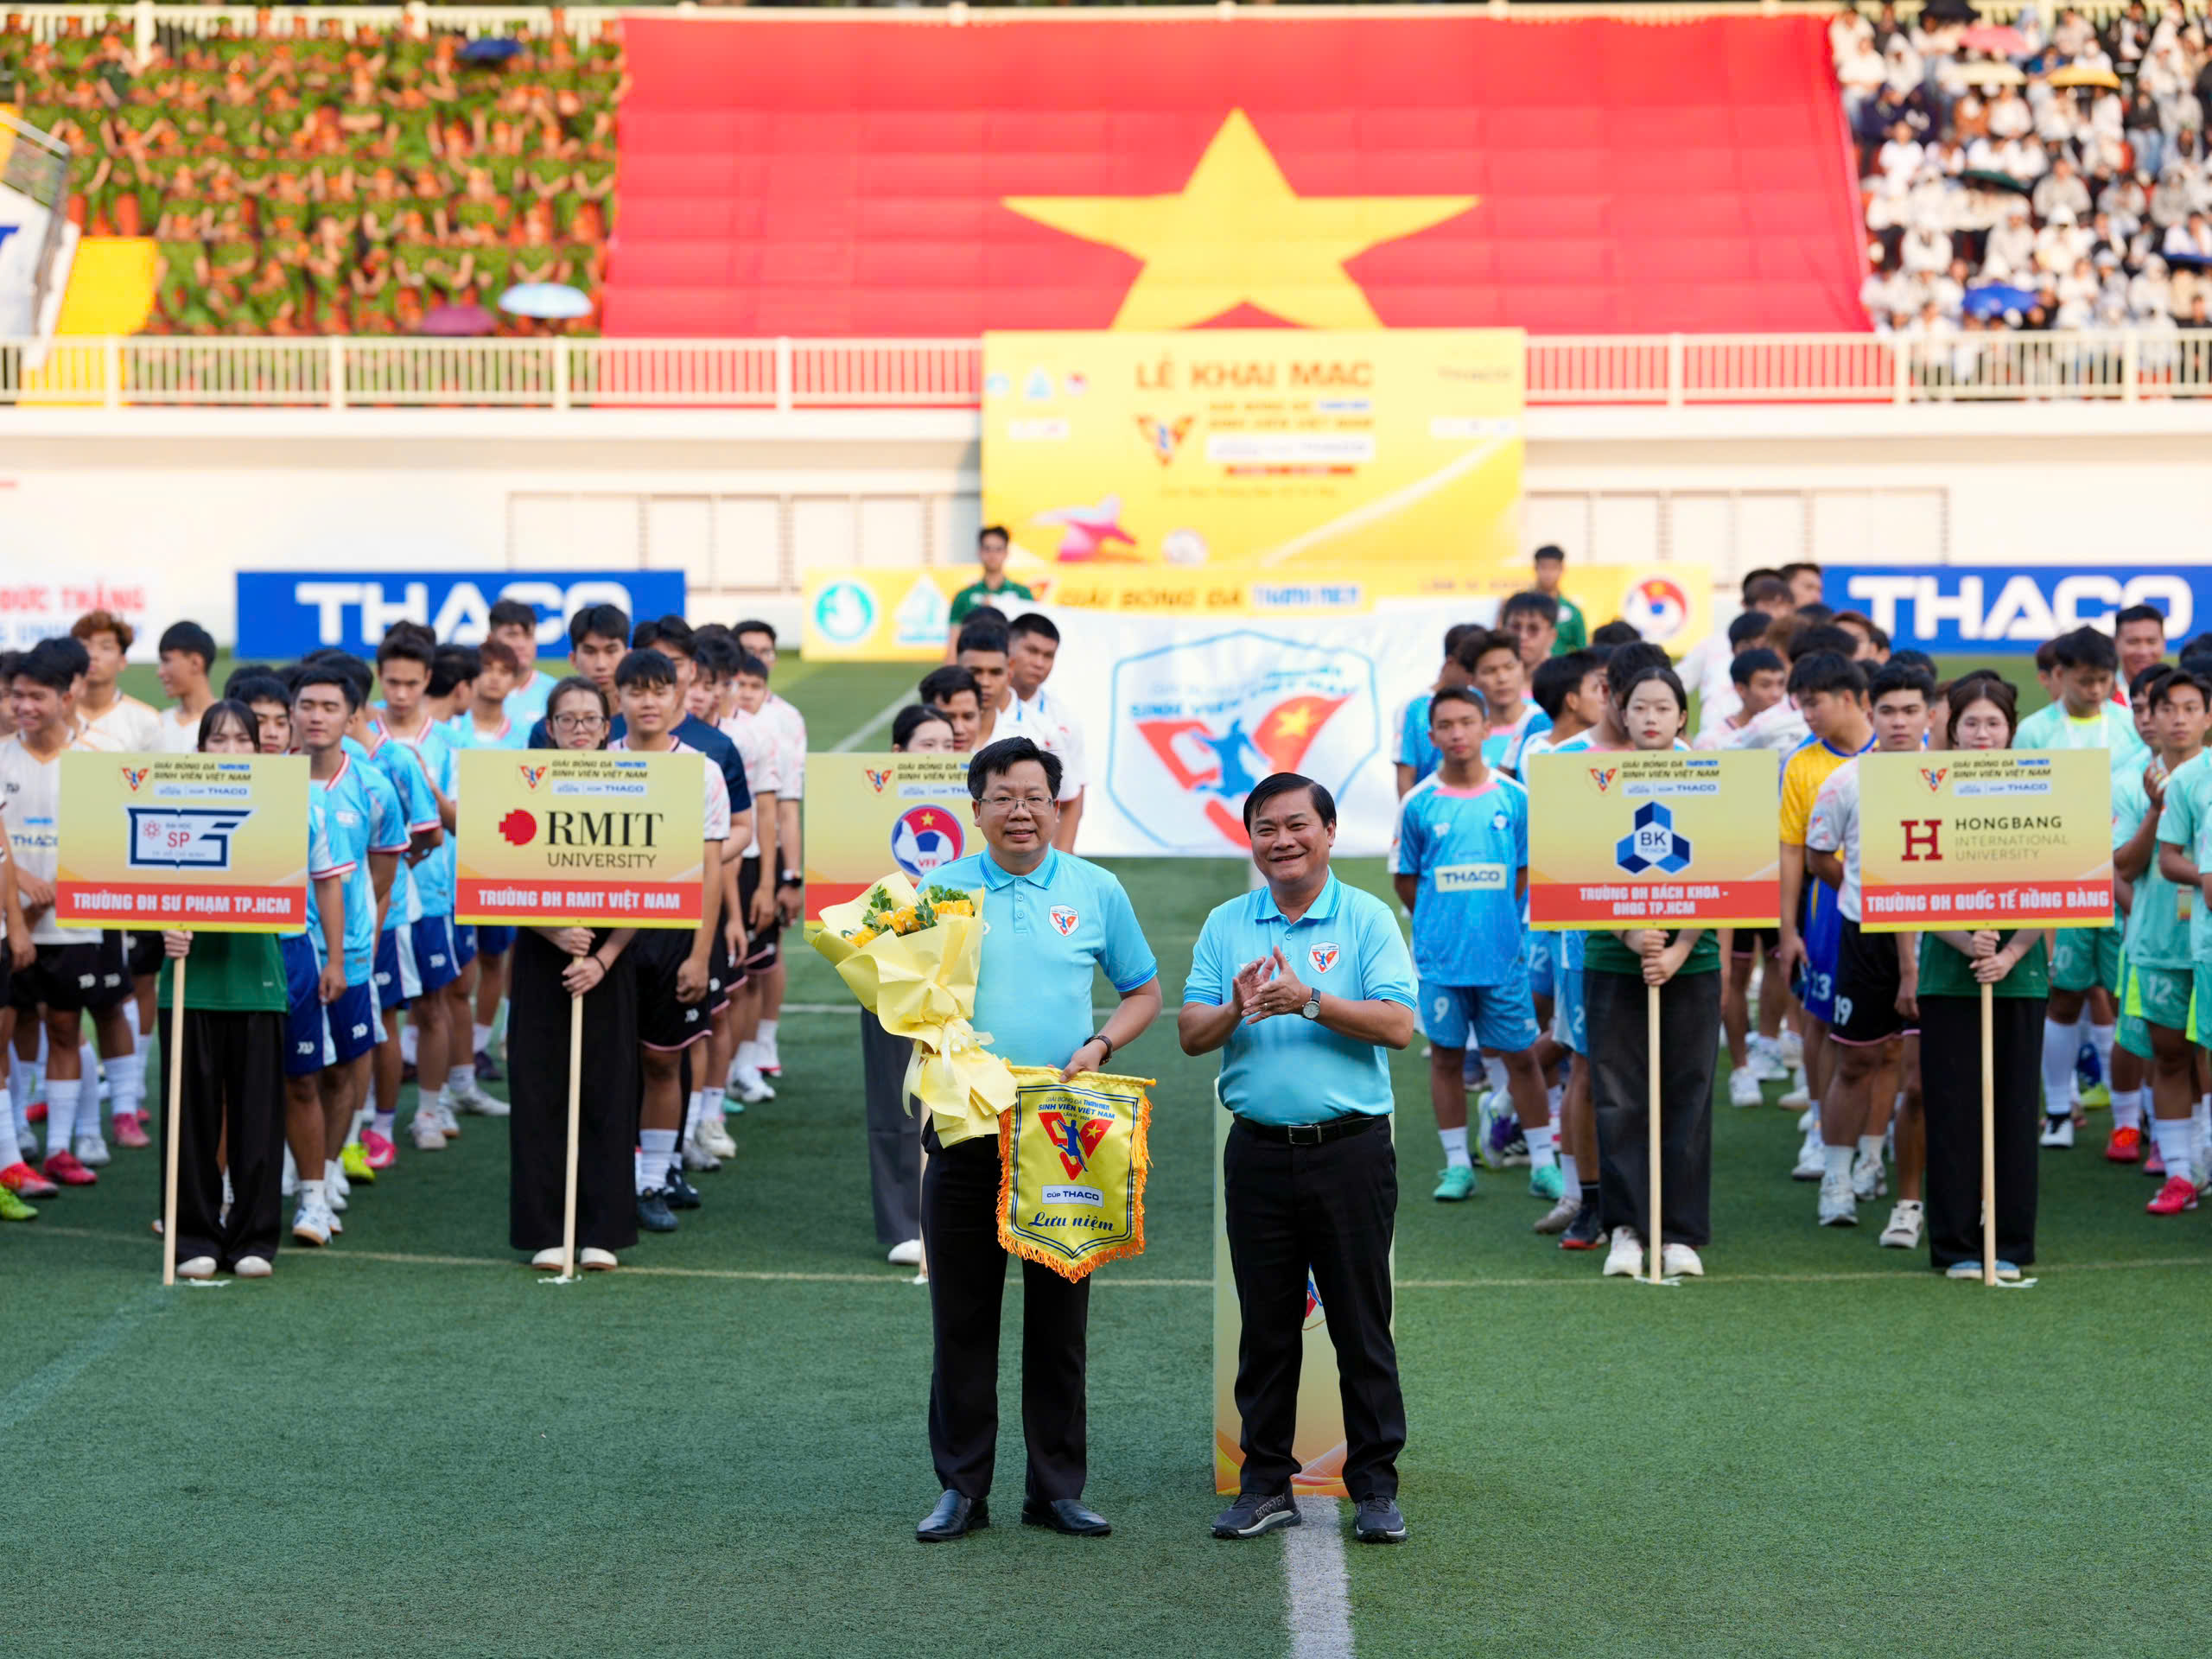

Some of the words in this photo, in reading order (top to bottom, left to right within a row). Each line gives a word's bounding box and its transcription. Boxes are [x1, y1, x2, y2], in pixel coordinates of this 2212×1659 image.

[1848, 575, 2193, 639] THACO
[1676, 784, 1716, 792] THACO
[544, 810, 664, 848] RMIT
[1955, 816, 2063, 830] HONGBANG
[167, 831, 190, 848] SP
[1641, 832, 1666, 846] BK
[1900, 819, 1943, 861] H
[1955, 834, 2068, 848] INTERNATIONAL
[547, 852, 657, 868] UNIVERSITY
[1955, 849, 2040, 861] UNIVERSITY
[1441, 870, 1500, 884] THACO
[479, 887, 537, 906] TRƯỜNG
[566, 892, 605, 908] RMIT
[608, 889, 640, 912] VIỆT
[644, 893, 680, 910] NAM
[1687, 886, 1719, 899] KHOA
[1866, 891, 1926, 912] TRƯỜNG
[2067, 887, 2109, 907] BÀNG
[73, 889, 133, 909] TRƯỜNG
[186, 895, 230, 914] PHẠM
[234, 896, 291, 913] TP.HCM
[1649, 901, 1695, 915] TP.HCM
[2149, 974, 2172, 1004] 12
[1433, 996, 1449, 1022] 9
[1834, 995, 1853, 1026] 19
[1058, 1103, 1077, 1111] VIÊN
[1077, 1106, 1096, 1116] VIỆT
[1097, 1110, 1116, 1119] NAM
[1063, 1191, 1099, 1201] THACO
[1028, 1211, 1067, 1227] Lưu
[1072, 1214, 1114, 1231] niệm
